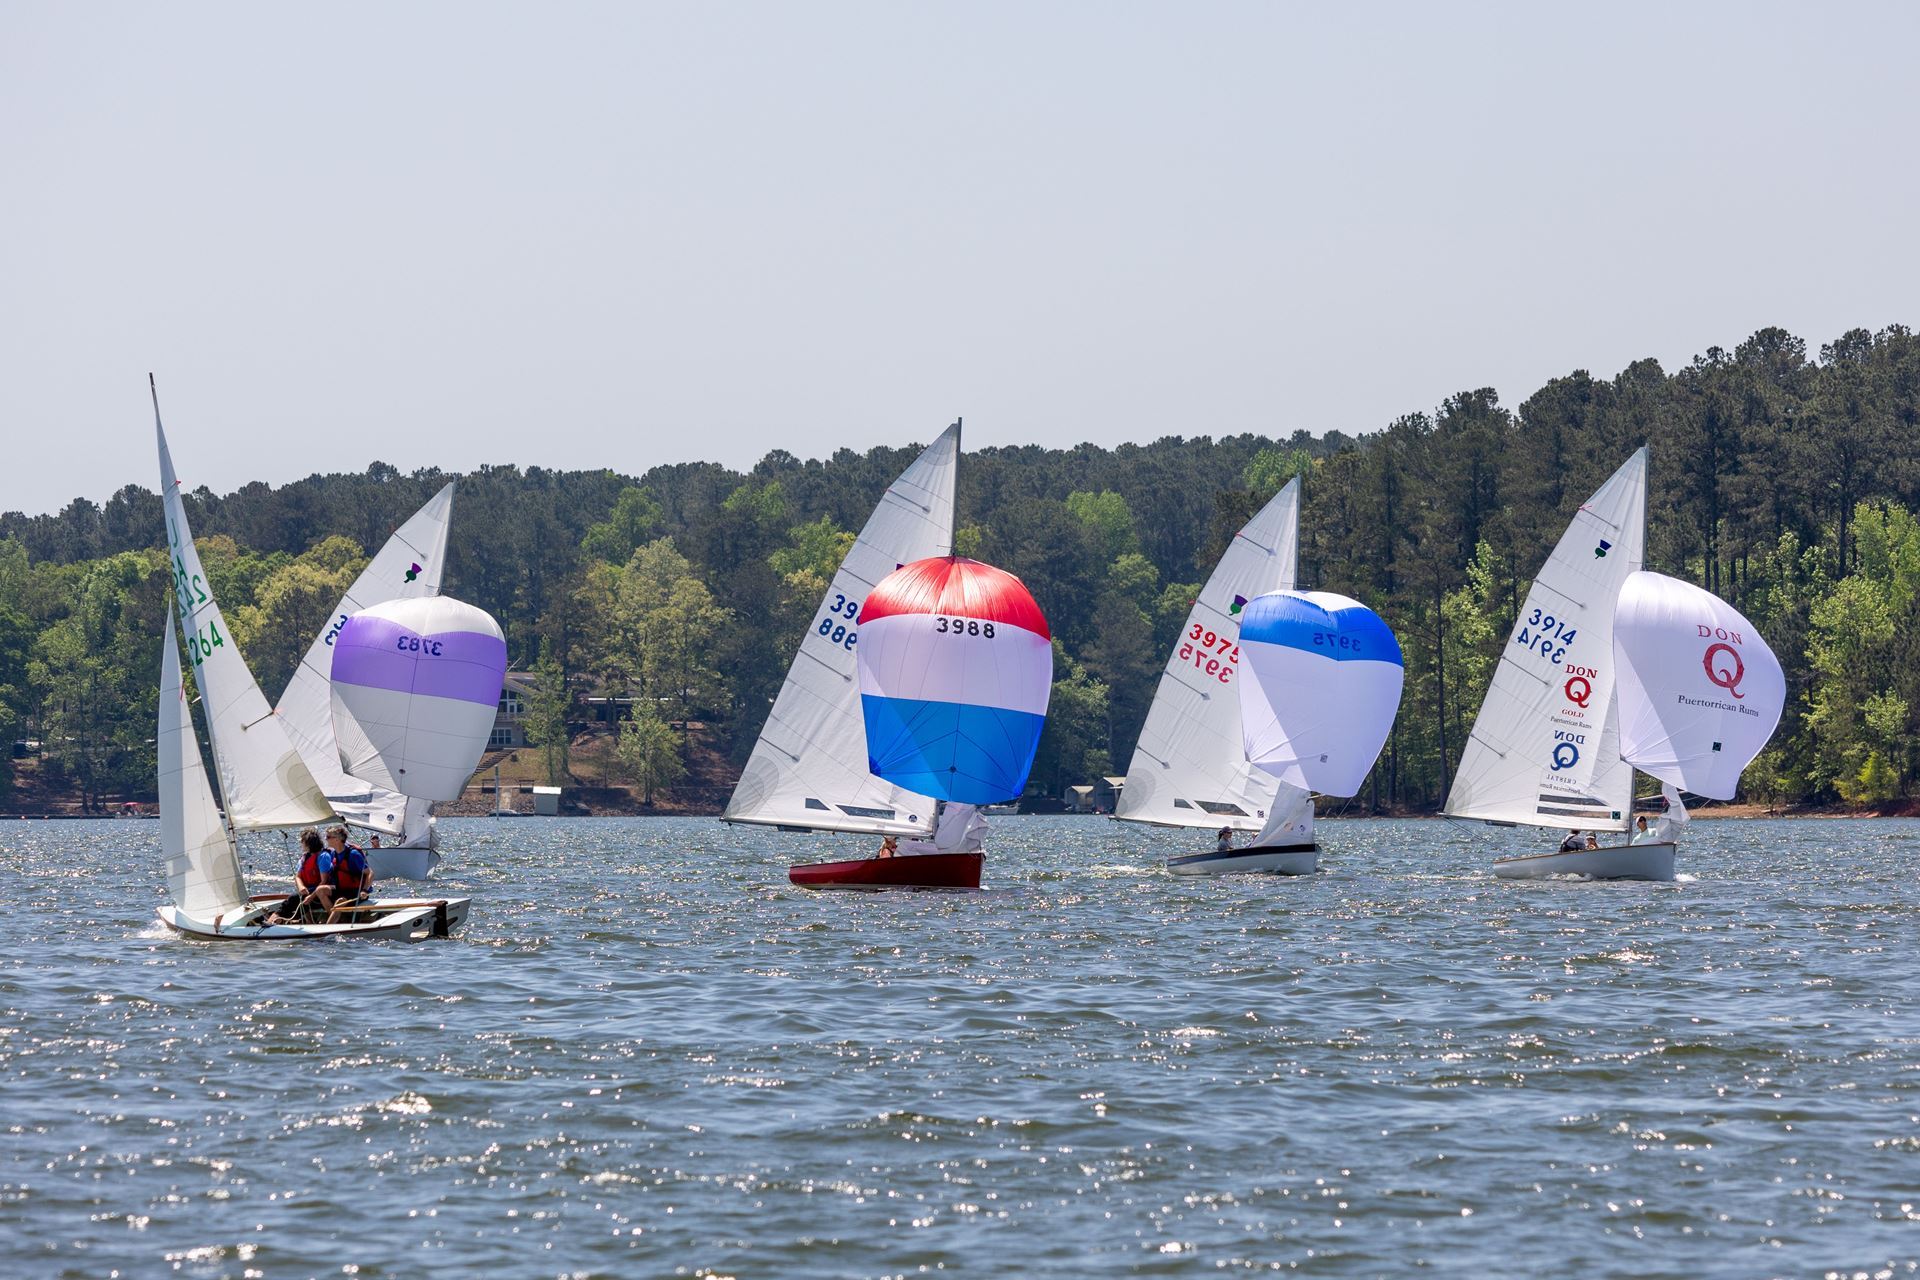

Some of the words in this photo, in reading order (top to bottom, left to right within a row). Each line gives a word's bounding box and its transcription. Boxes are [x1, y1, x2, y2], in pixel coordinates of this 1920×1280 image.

[936, 617, 995, 639] 3988
[1529, 609, 1577, 646] 3914
[1697, 625, 1743, 645] DON
[189, 620, 224, 669] 264
[1189, 624, 1239, 664] 3975
[1565, 664, 1598, 679] DON
[1702, 643, 1745, 699] Q
[1563, 676, 1593, 708] Q
[1561, 708, 1585, 718] GOLD
[1678, 695, 1737, 712] Puertorrican
[1739, 705, 1759, 717] Rums
